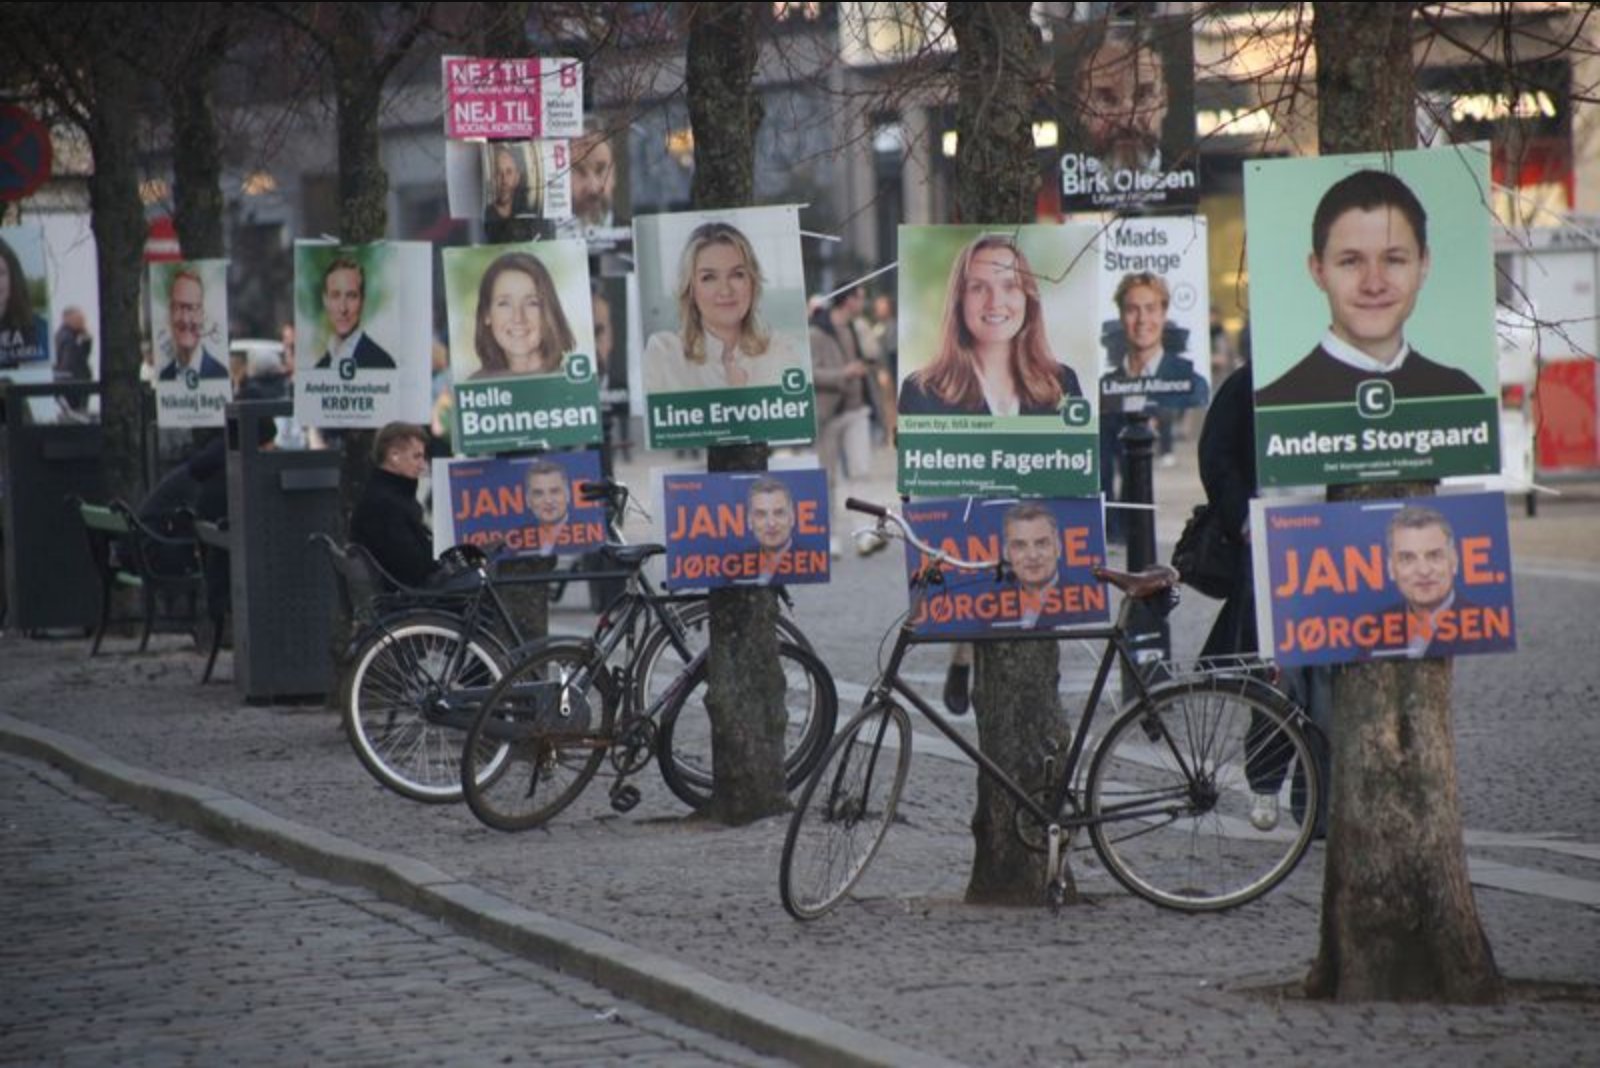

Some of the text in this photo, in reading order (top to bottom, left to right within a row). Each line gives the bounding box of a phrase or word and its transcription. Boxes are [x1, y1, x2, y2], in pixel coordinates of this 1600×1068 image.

[500, 63, 536, 84] TIL
[454, 100, 536, 122] NEJ TIL
[1063, 172, 1110, 195] Birk
[1115, 229, 1167, 246] Mads
[1104, 253, 1181, 273] Strange
[571, 359, 585, 377] C
[787, 372, 800, 388] C
[321, 396, 375, 411] KRØYER
[459, 387, 513, 409] Helle
[1365, 387, 1384, 409] C
[461, 405, 598, 436] Bonnesen
[653, 397, 809, 427] Line Ervolder
[1069, 403, 1084, 421] C
[1266, 421, 1489, 456] Anders Storgaard
[904, 449, 1093, 475] Helene Fagerhøj
[456, 484, 525, 520] JAN
[670, 500, 826, 541] JAN E.
[1064, 527, 1100, 568] E.
[672, 551, 827, 579] JØRGENSEN
[1275, 536, 1505, 599] JAN E.
[912, 585, 1105, 625] JØRGENSEN
[1280, 606, 1510, 651] JØRGENSEN
